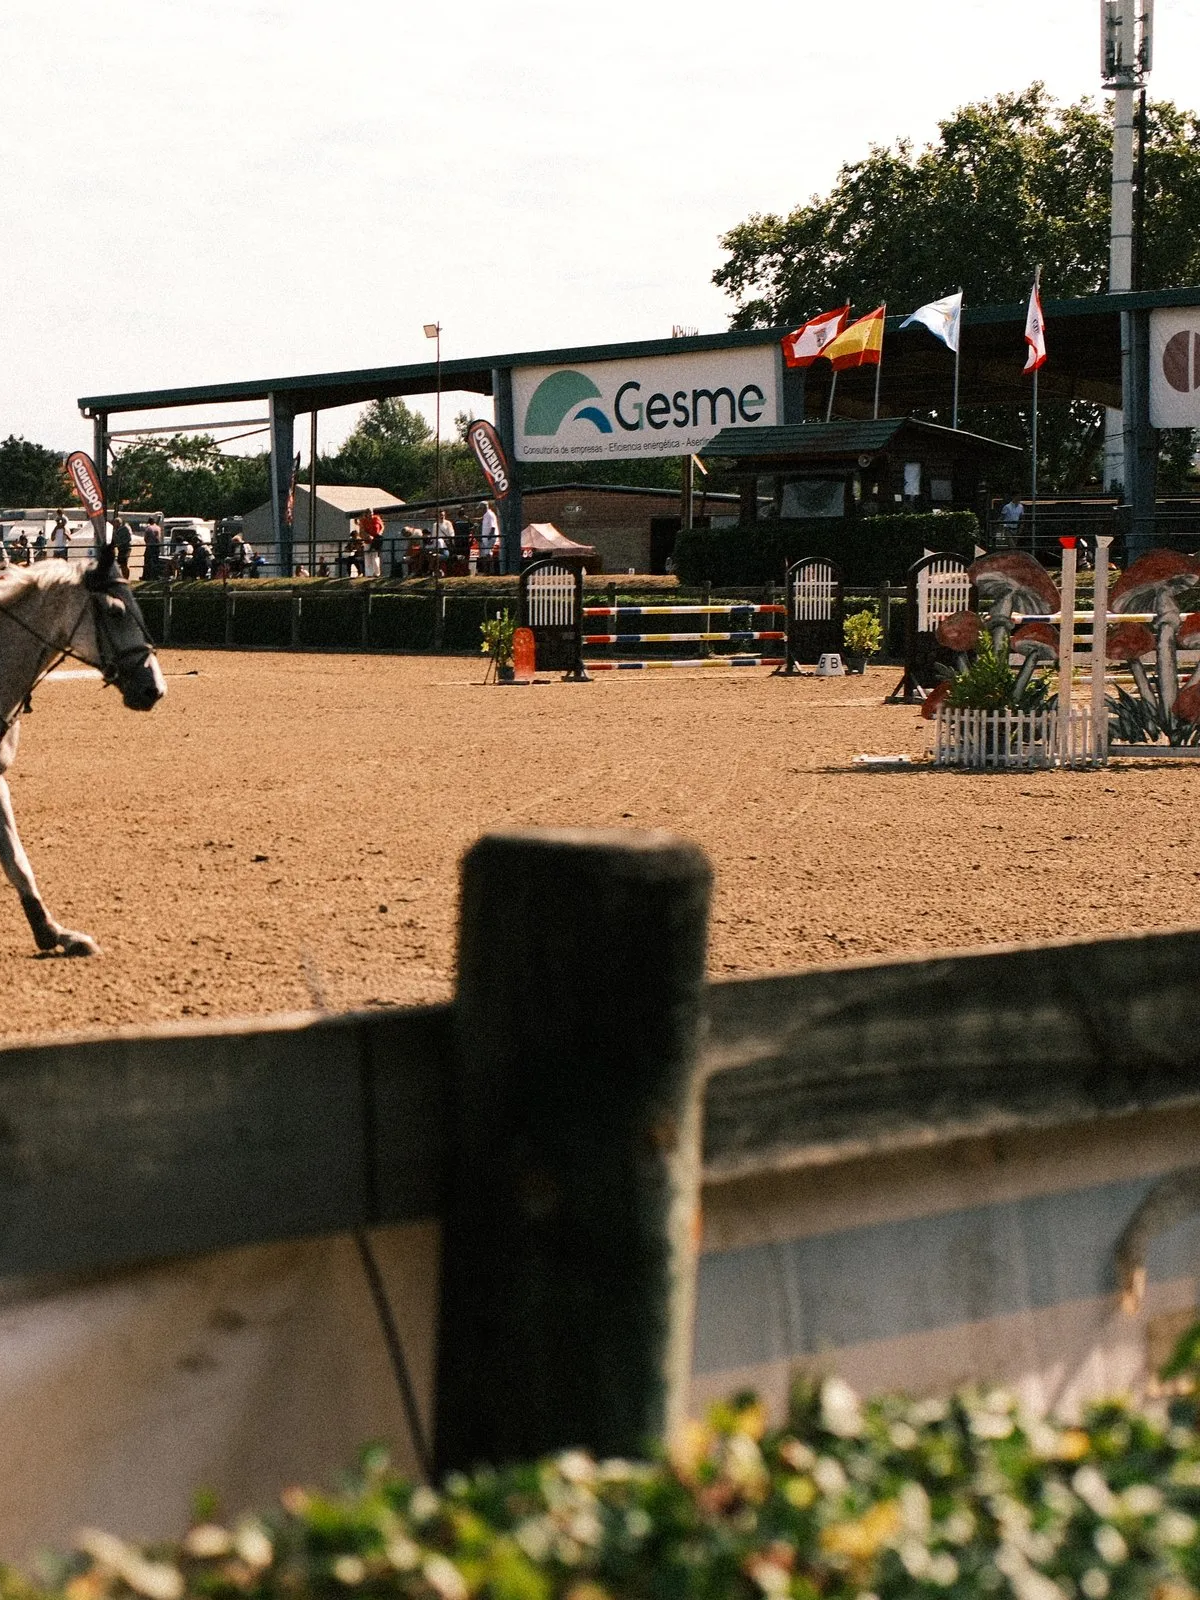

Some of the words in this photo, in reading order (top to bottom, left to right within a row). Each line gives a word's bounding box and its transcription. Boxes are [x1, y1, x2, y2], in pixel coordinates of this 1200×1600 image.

[614, 381, 767, 431] Gesme
[561, 446, 569, 454] de
[571, 445, 603, 455] empresas
[609, 442, 641, 453] Eficiencia
[644, 439, 681, 451] energética
[831, 657, 839, 668] B
